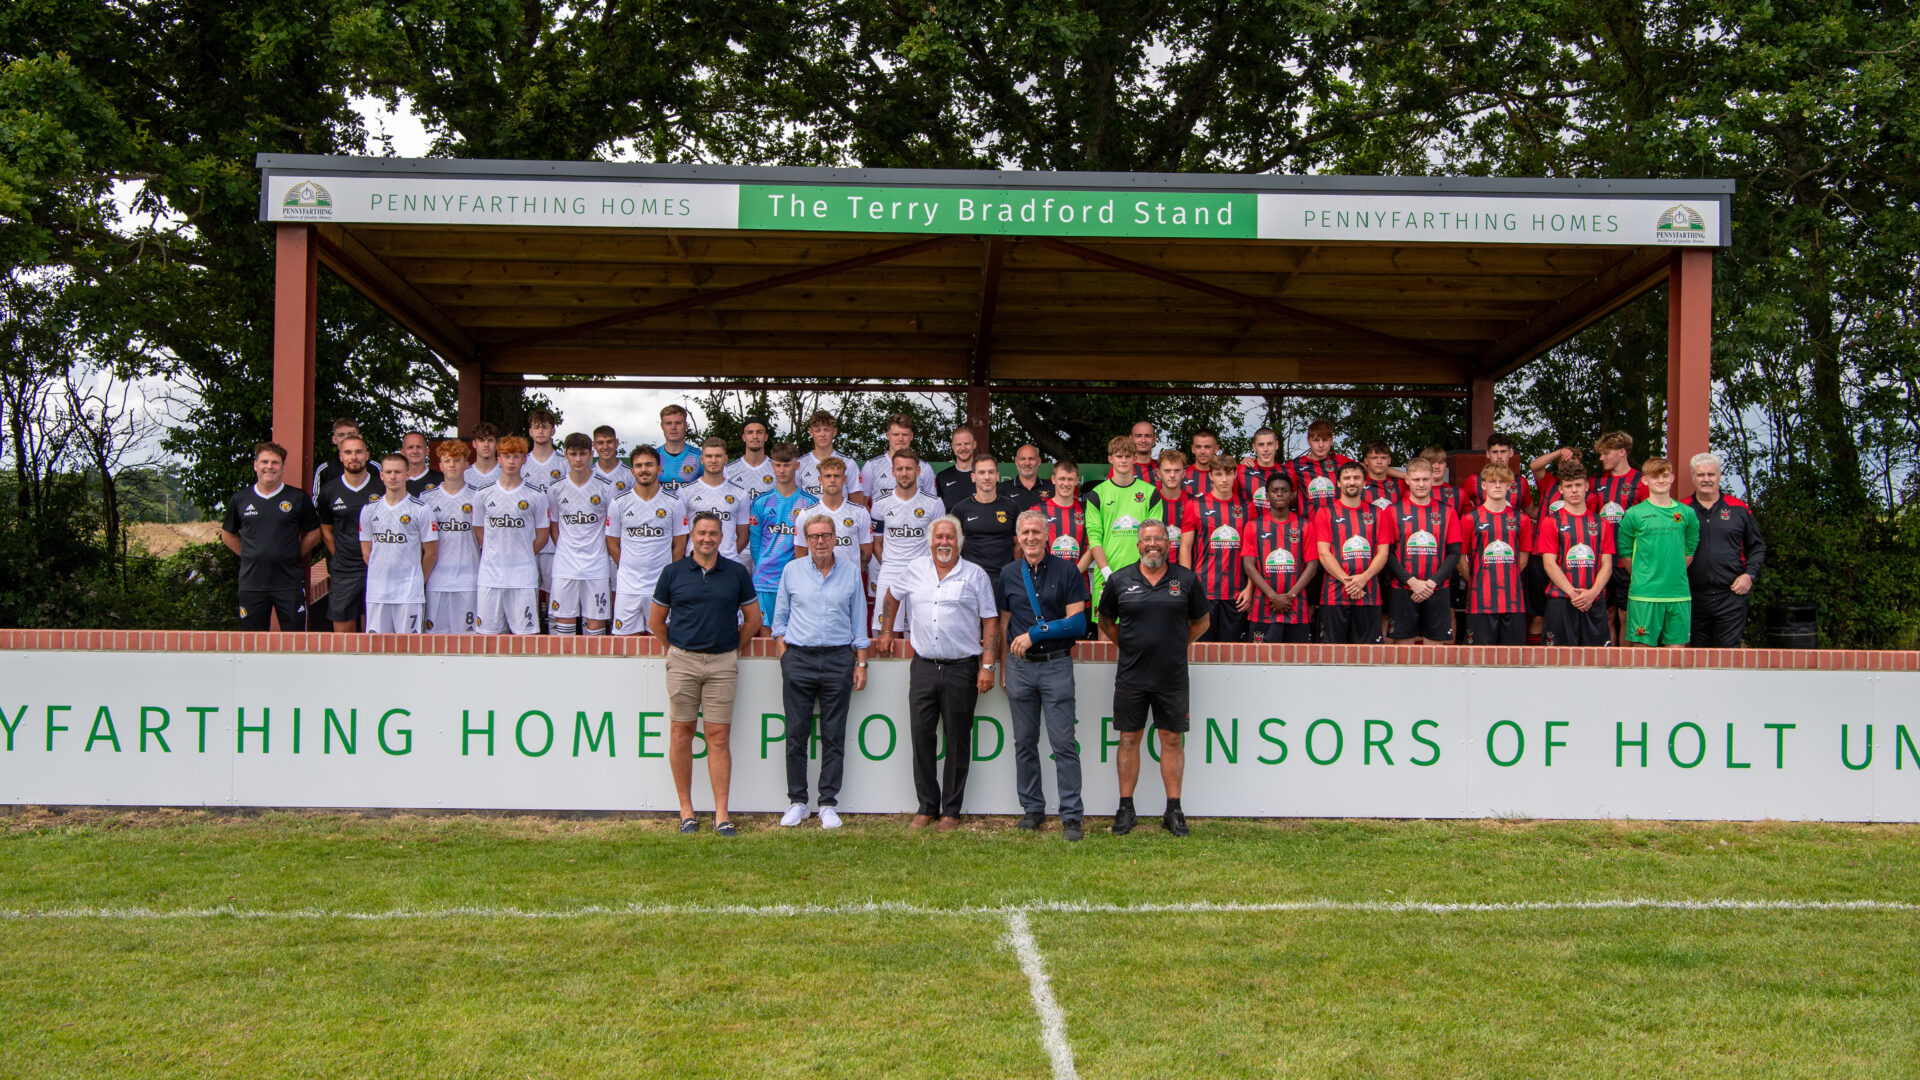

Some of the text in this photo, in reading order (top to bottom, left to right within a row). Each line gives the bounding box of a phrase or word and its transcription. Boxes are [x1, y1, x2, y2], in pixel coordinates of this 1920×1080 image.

[282, 207, 333, 215] PENNYFARTHING
[371, 193, 691, 216] PENNYFARTHING HOMES
[768, 194, 1232, 226] The Terry Bradford Stand
[1304, 209, 1619, 232] PENNYFARTHING HOMES
[488, 514, 525, 528] veho
[562, 511, 599, 525] veho
[372, 530, 408, 544] veho
[626, 524, 664, 538] veho
[887, 524, 925, 538] veho
[594, 592, 607, 607] 14
[409, 615, 418, 629] 7
[465, 611, 475, 625] 8
[0, 705, 412, 756] YFARTHING
[1486, 719, 1569, 767] OF
[1616, 721, 1797, 769] HOLT
[1841, 724, 1920, 771] UN
